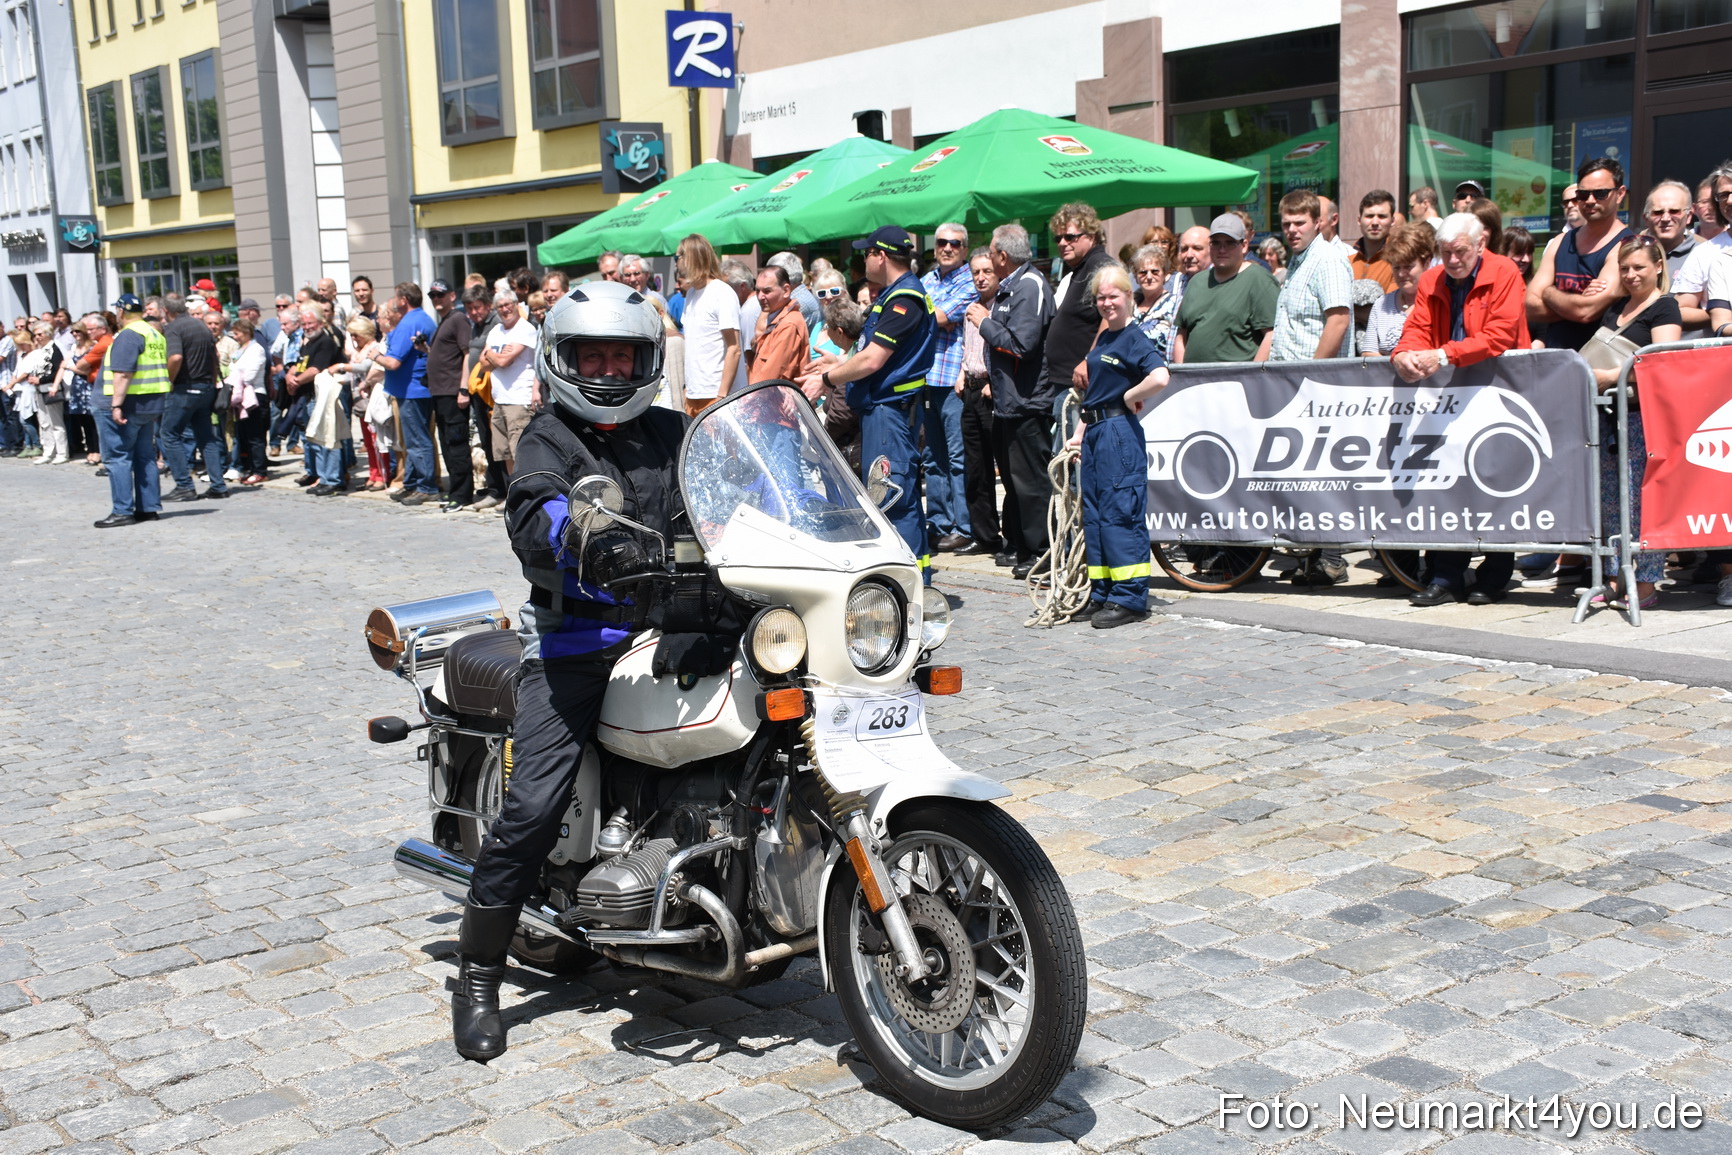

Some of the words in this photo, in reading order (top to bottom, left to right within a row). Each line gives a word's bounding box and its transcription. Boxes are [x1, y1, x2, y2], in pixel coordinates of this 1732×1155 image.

[741, 110, 766, 124] Unterer
[767, 105, 786, 119] Markt
[788, 101, 797, 115] 15
[628, 141, 651, 171] G2
[1043, 163, 1167, 180] Lammsbräu
[1297, 394, 1460, 418] Autoklassik
[1252, 422, 1448, 472] Dietz
[1245, 480, 1350, 492] BREITENBRUNN
[868, 705, 909, 731] 283
